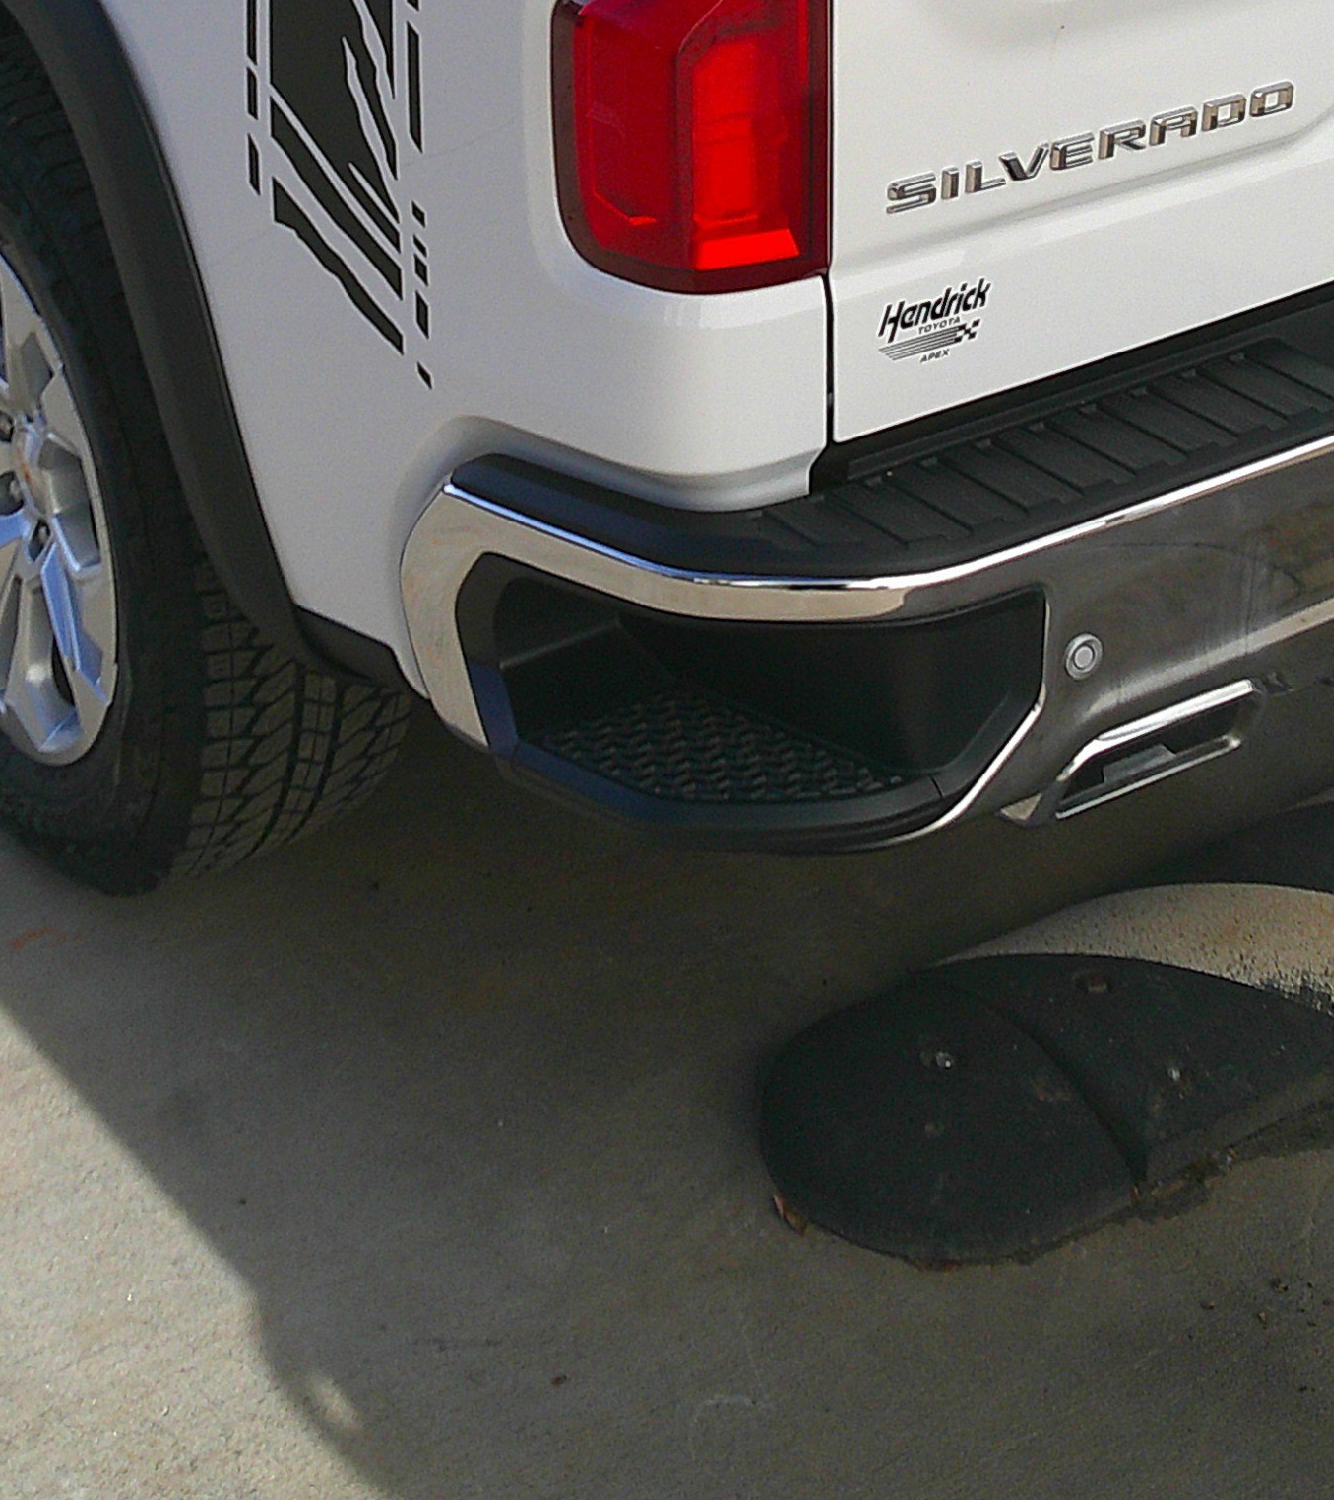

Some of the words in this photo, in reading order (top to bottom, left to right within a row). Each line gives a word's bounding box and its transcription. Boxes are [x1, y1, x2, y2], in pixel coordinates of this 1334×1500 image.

[886, 80, 1295, 215] SILVERADO
[877, 277, 992, 344] Hendrick
[917, 315, 961, 335] TOYOTA
[919, 348, 950, 363] APEX
